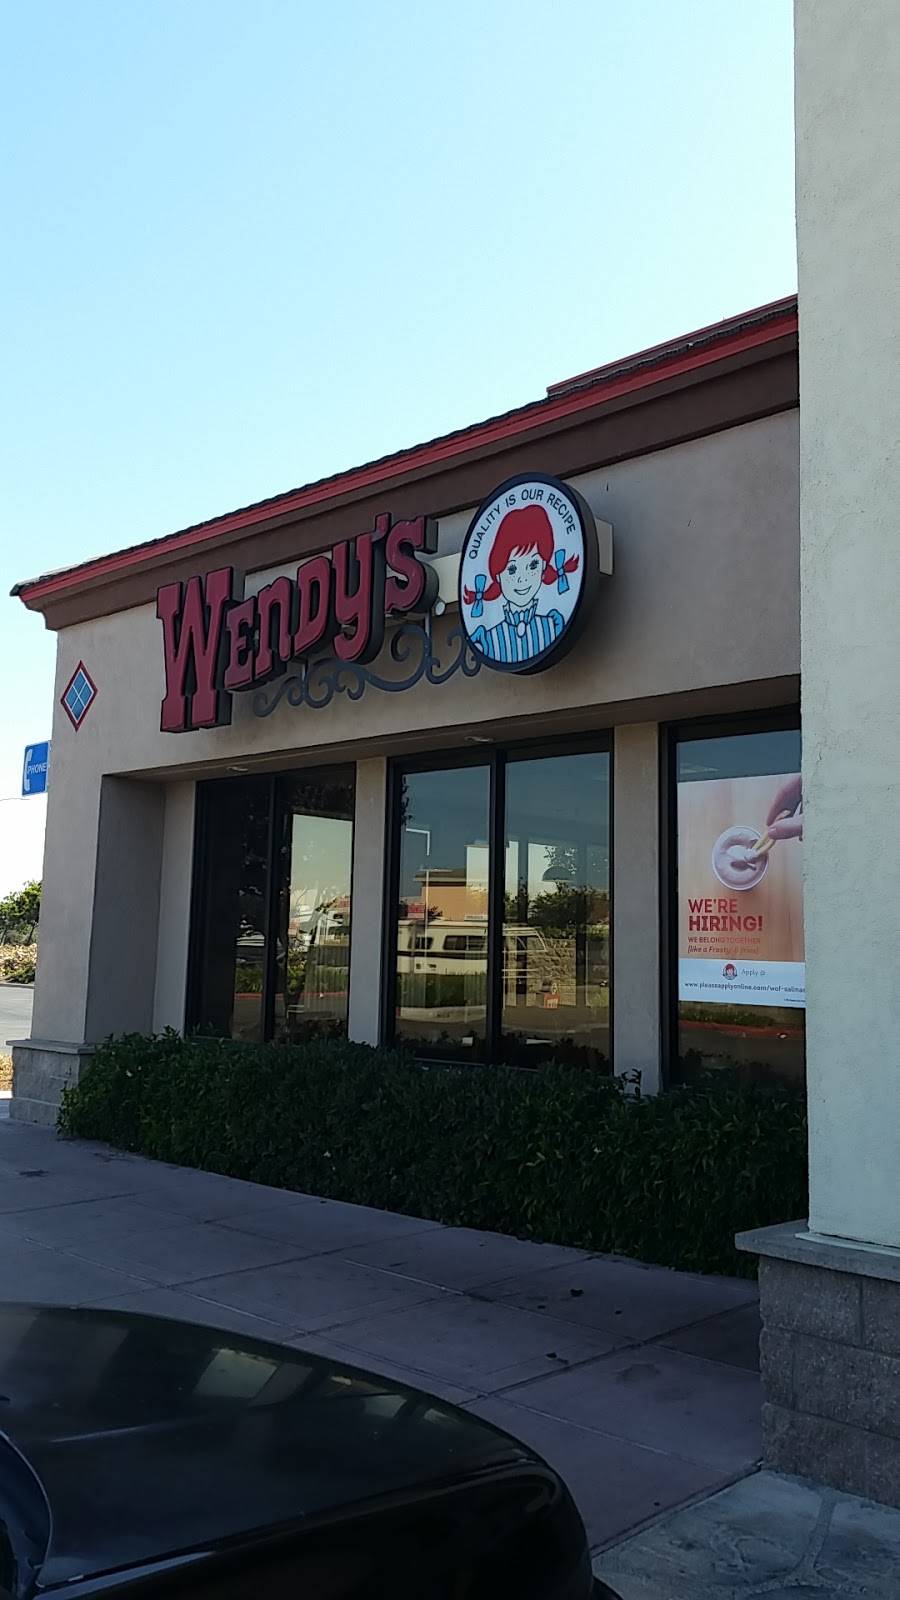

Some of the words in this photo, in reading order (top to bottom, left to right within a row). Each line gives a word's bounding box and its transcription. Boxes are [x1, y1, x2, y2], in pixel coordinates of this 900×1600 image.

[468, 504, 501, 560] QUALITY
[505, 493, 516, 508] IS
[521, 489, 545, 501] OUR
[546, 493, 576, 535] RECIPE
[156, 512, 428, 732] Wendy's
[27, 762, 47, 775] PHONE
[687, 898, 738, 914] WE'RE
[688, 915, 763, 932] HIRING!
[687, 936, 698, 944] WE
[741, 968, 759, 977] Apply
